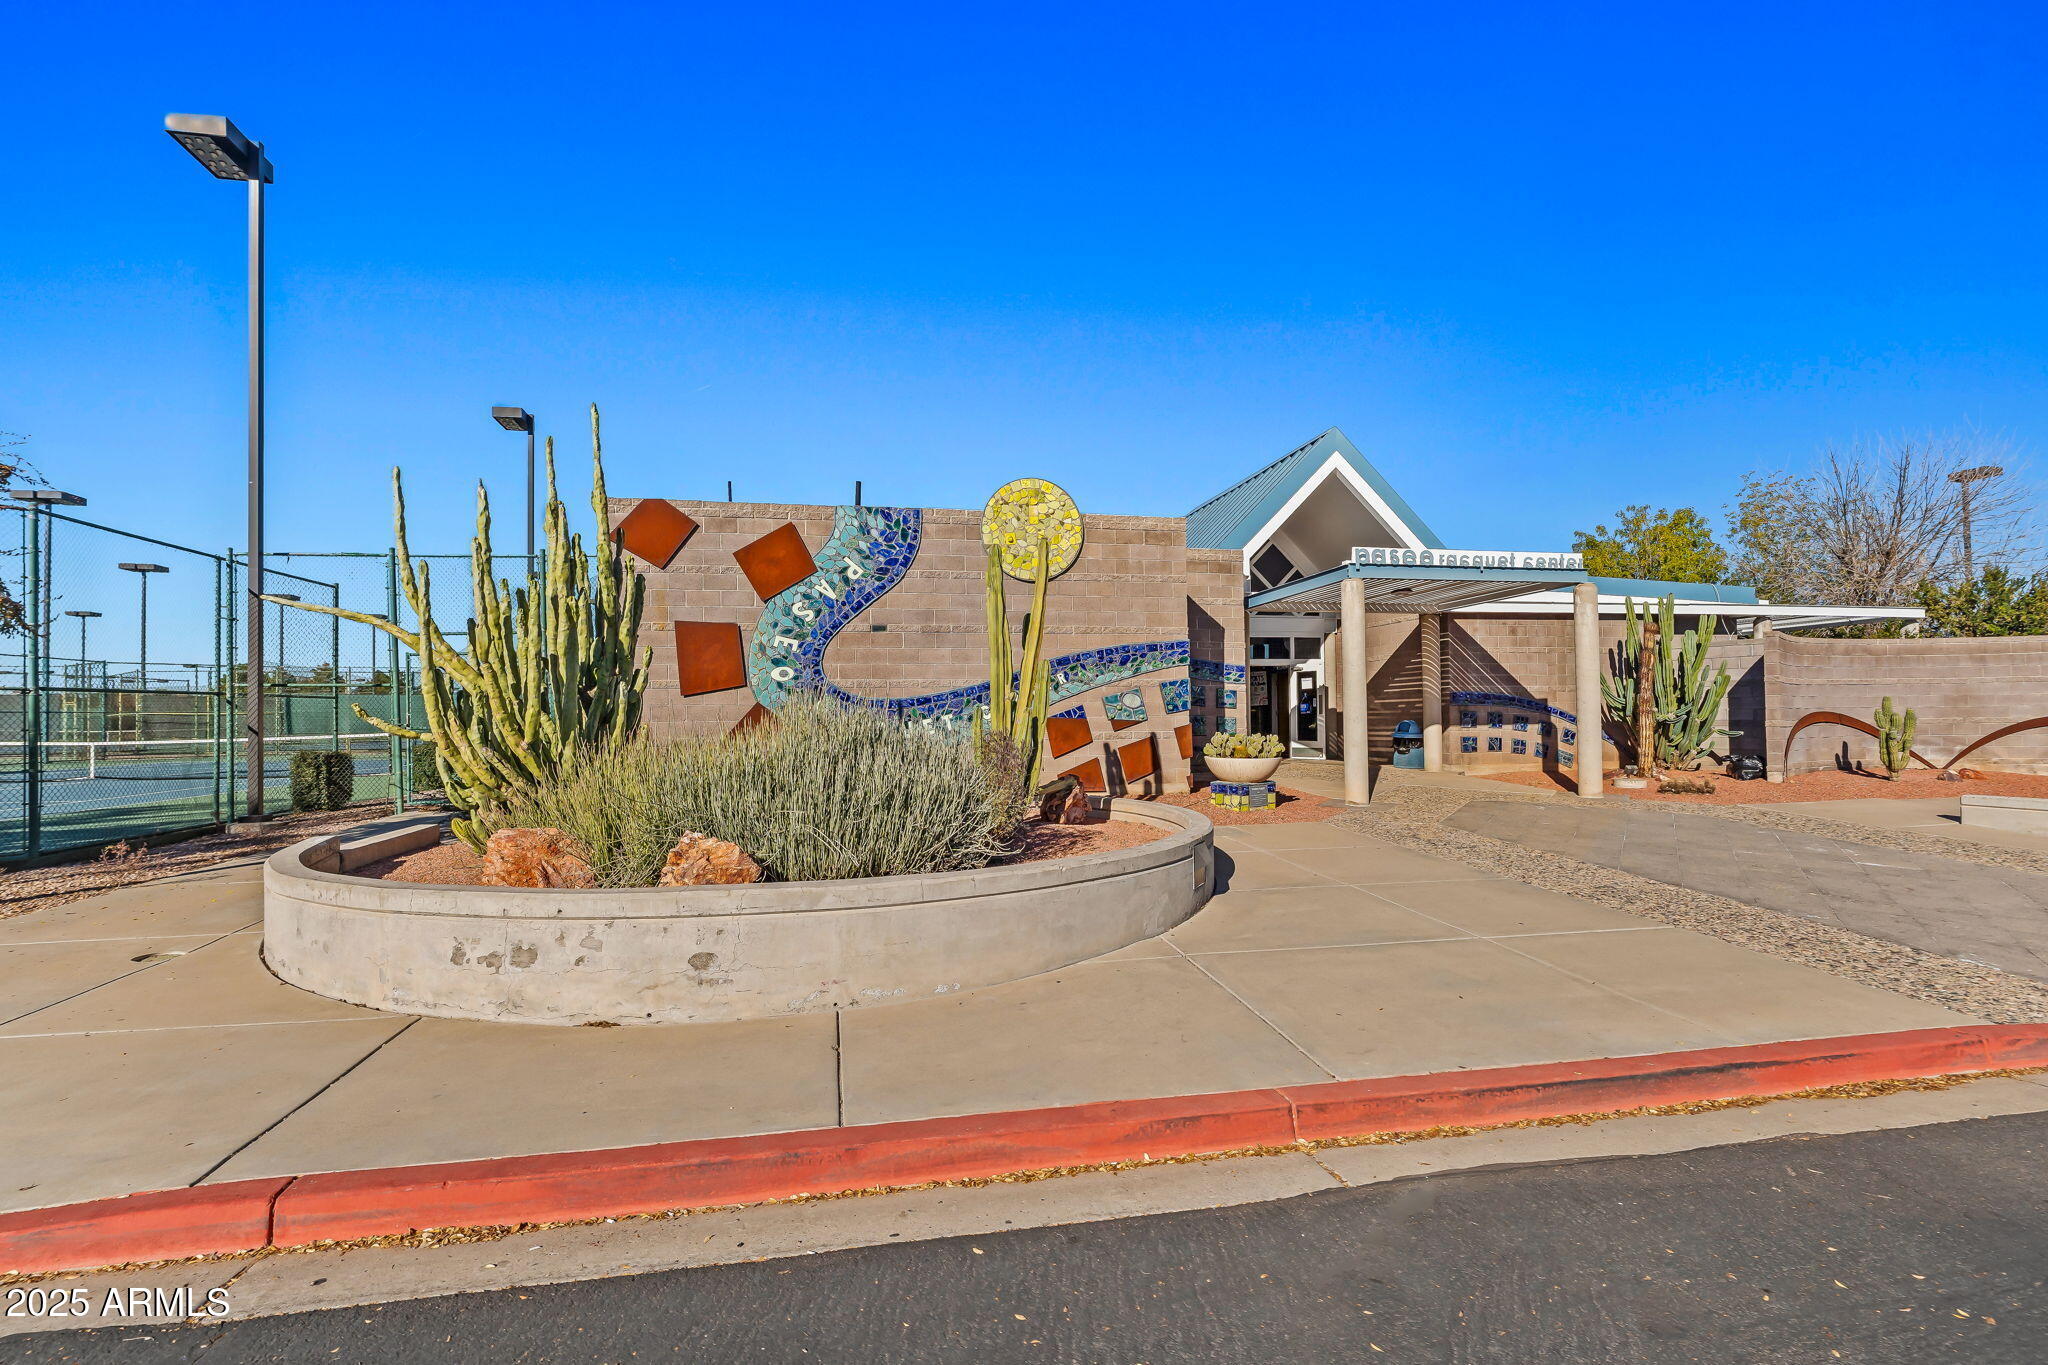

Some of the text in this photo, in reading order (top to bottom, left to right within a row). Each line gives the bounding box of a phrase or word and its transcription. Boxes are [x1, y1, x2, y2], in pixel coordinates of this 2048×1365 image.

[1354, 548, 1583, 571] paseo racquet center
[770, 556, 864, 682] PASEO
